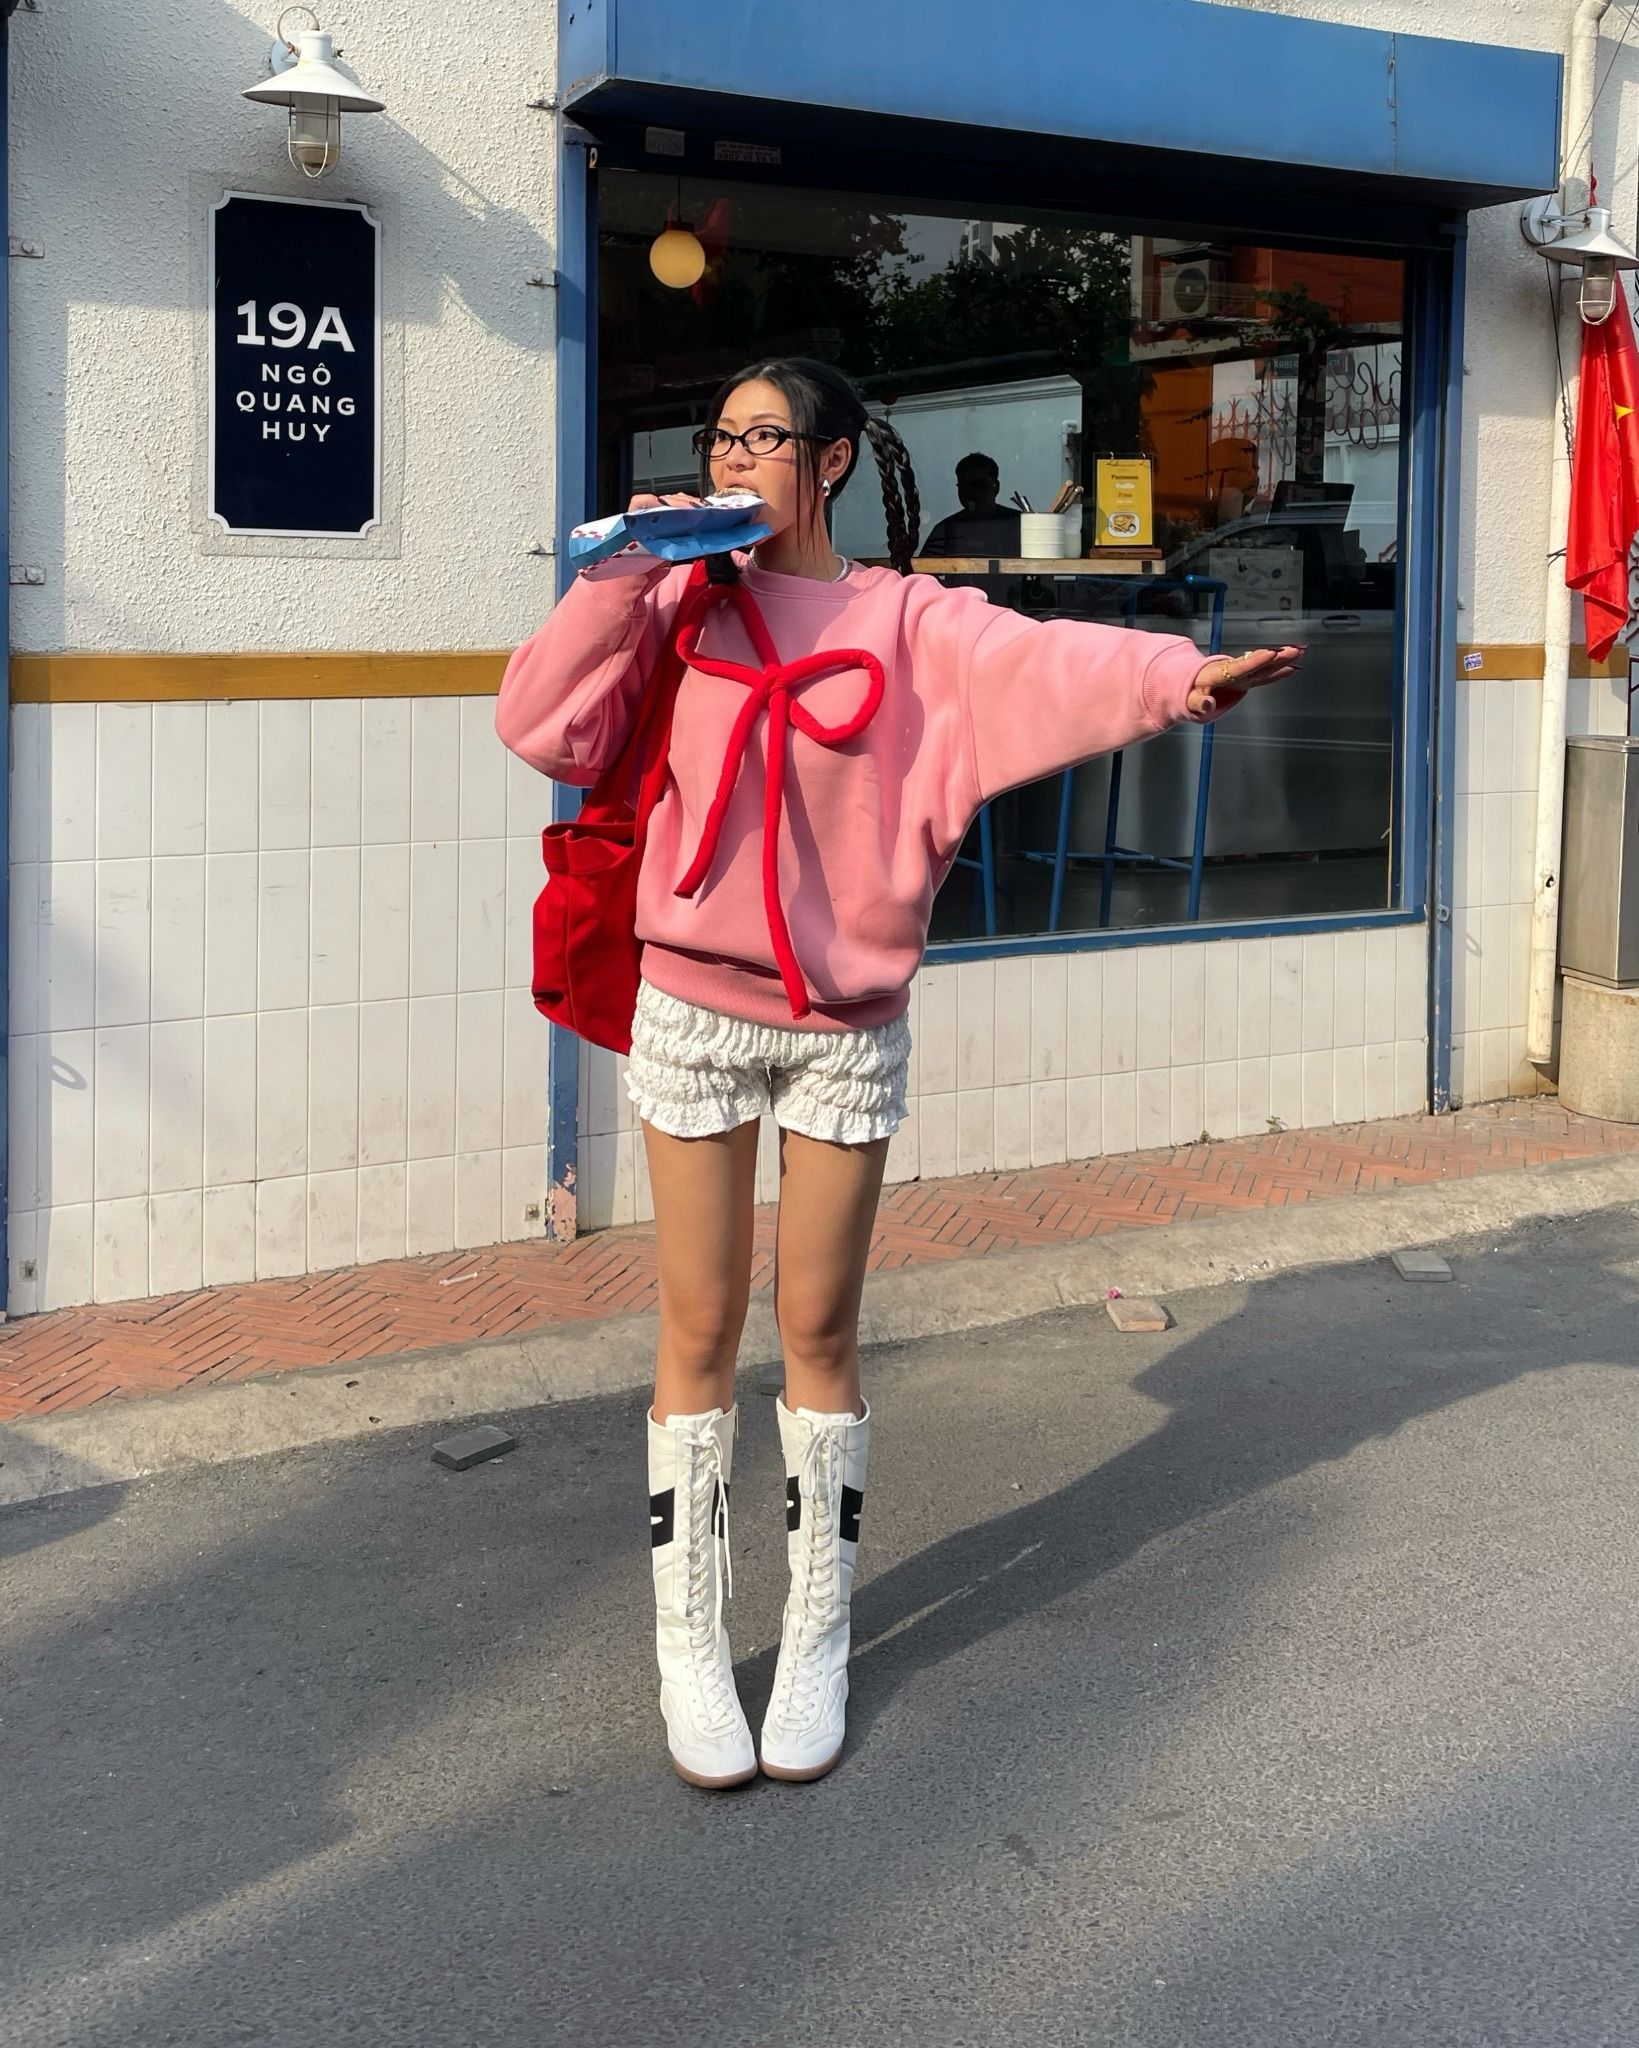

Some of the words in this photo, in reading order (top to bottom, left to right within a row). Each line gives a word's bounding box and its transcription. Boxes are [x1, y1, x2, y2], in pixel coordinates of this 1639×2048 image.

[237, 300, 356, 352] 19A
[261, 362, 332, 386] NGÔ
[236, 390, 356, 415] QUANG
[262, 420, 332, 442] HUY
